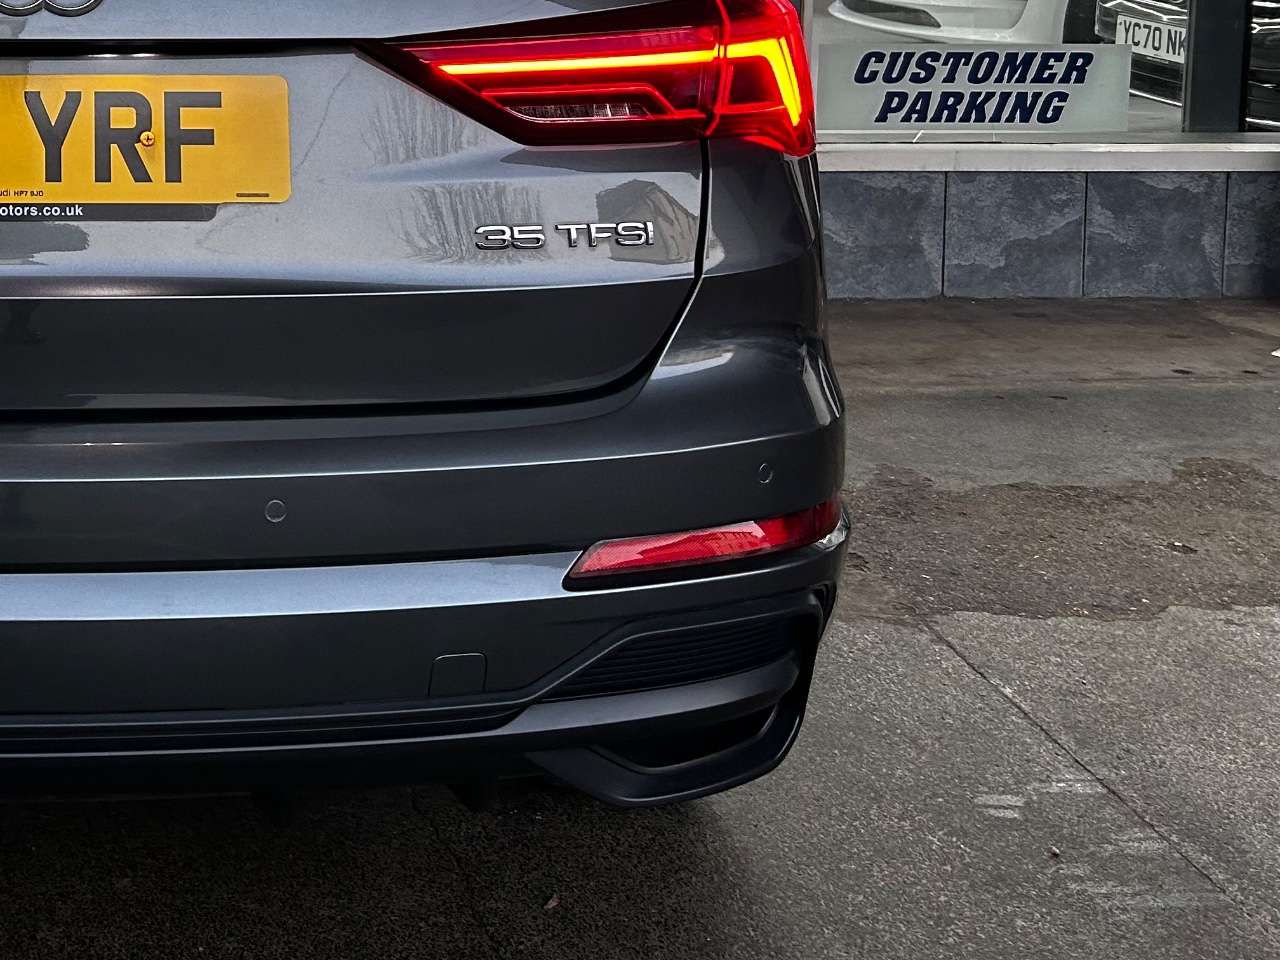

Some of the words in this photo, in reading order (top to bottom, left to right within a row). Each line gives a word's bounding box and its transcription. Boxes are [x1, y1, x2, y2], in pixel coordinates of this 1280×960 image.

[1123, 19, 1162, 52] YC70
[853, 51, 1095, 84] CUSTOMER
[874, 90, 1070, 123] PARKING
[24, 90, 223, 184] YRF
[474, 224, 545, 250] 35
[554, 221, 655, 248] TFSI
